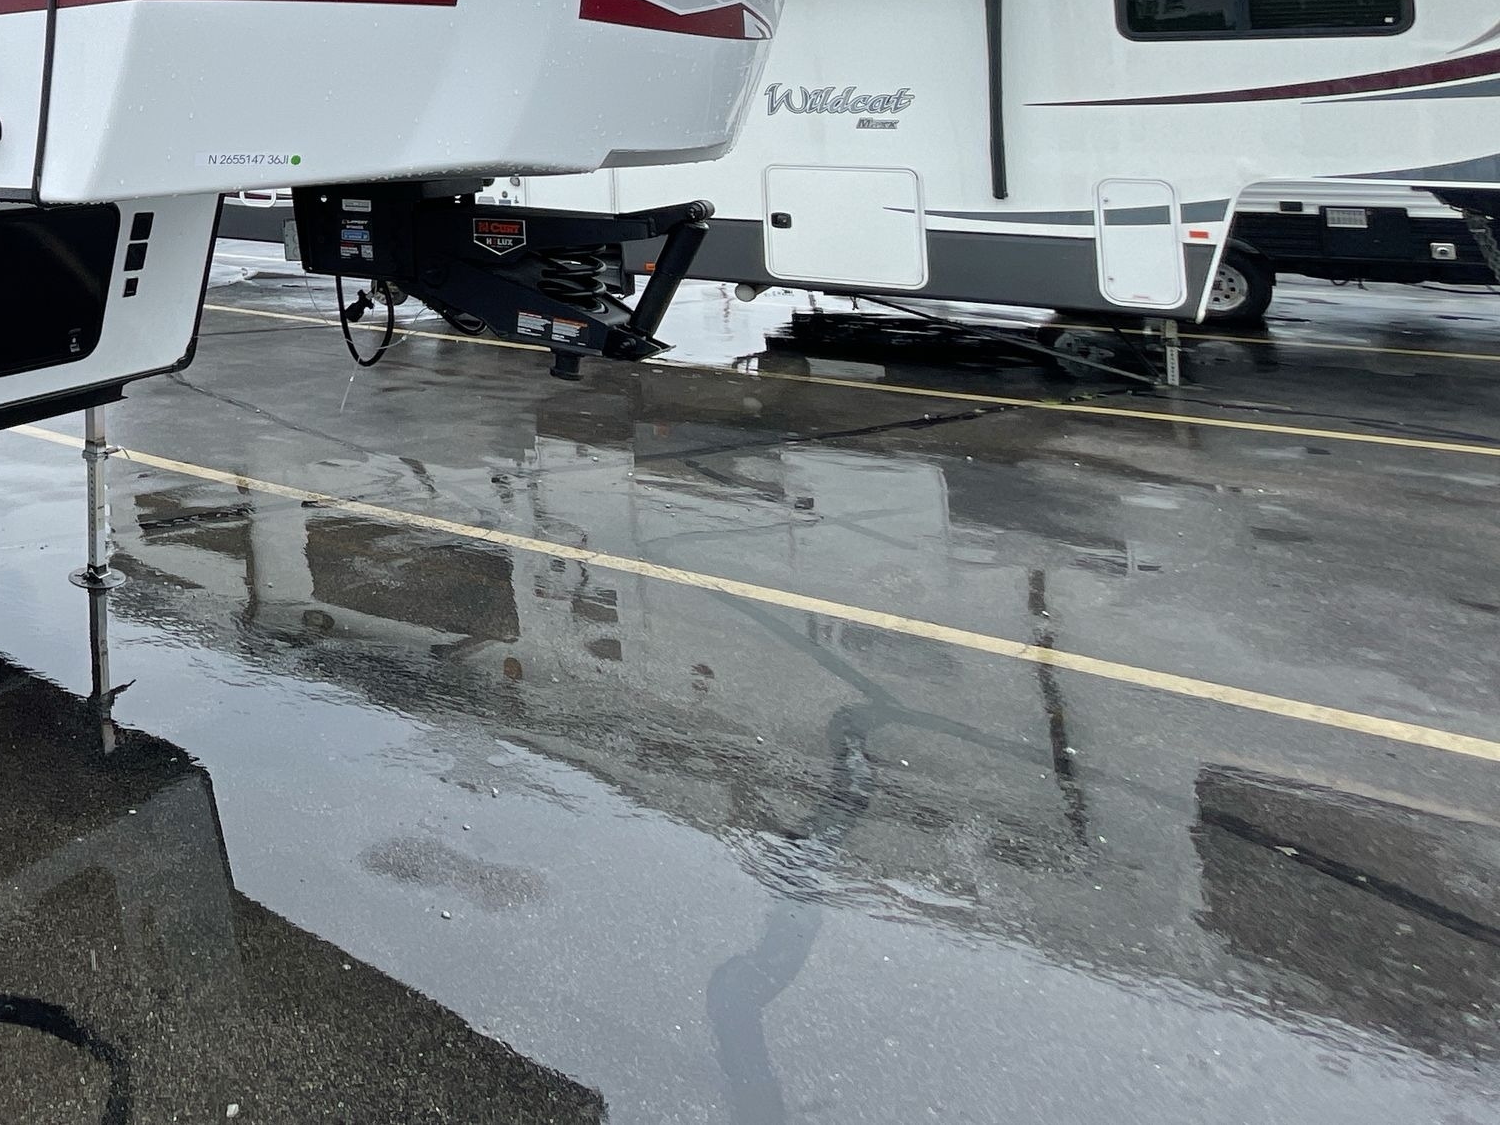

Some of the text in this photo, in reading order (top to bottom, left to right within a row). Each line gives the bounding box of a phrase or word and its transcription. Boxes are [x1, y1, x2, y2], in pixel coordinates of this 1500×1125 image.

[764, 82, 916, 116] Wildcat
[208, 154, 217, 165] N
[219, 154, 265, 165] 2655147
